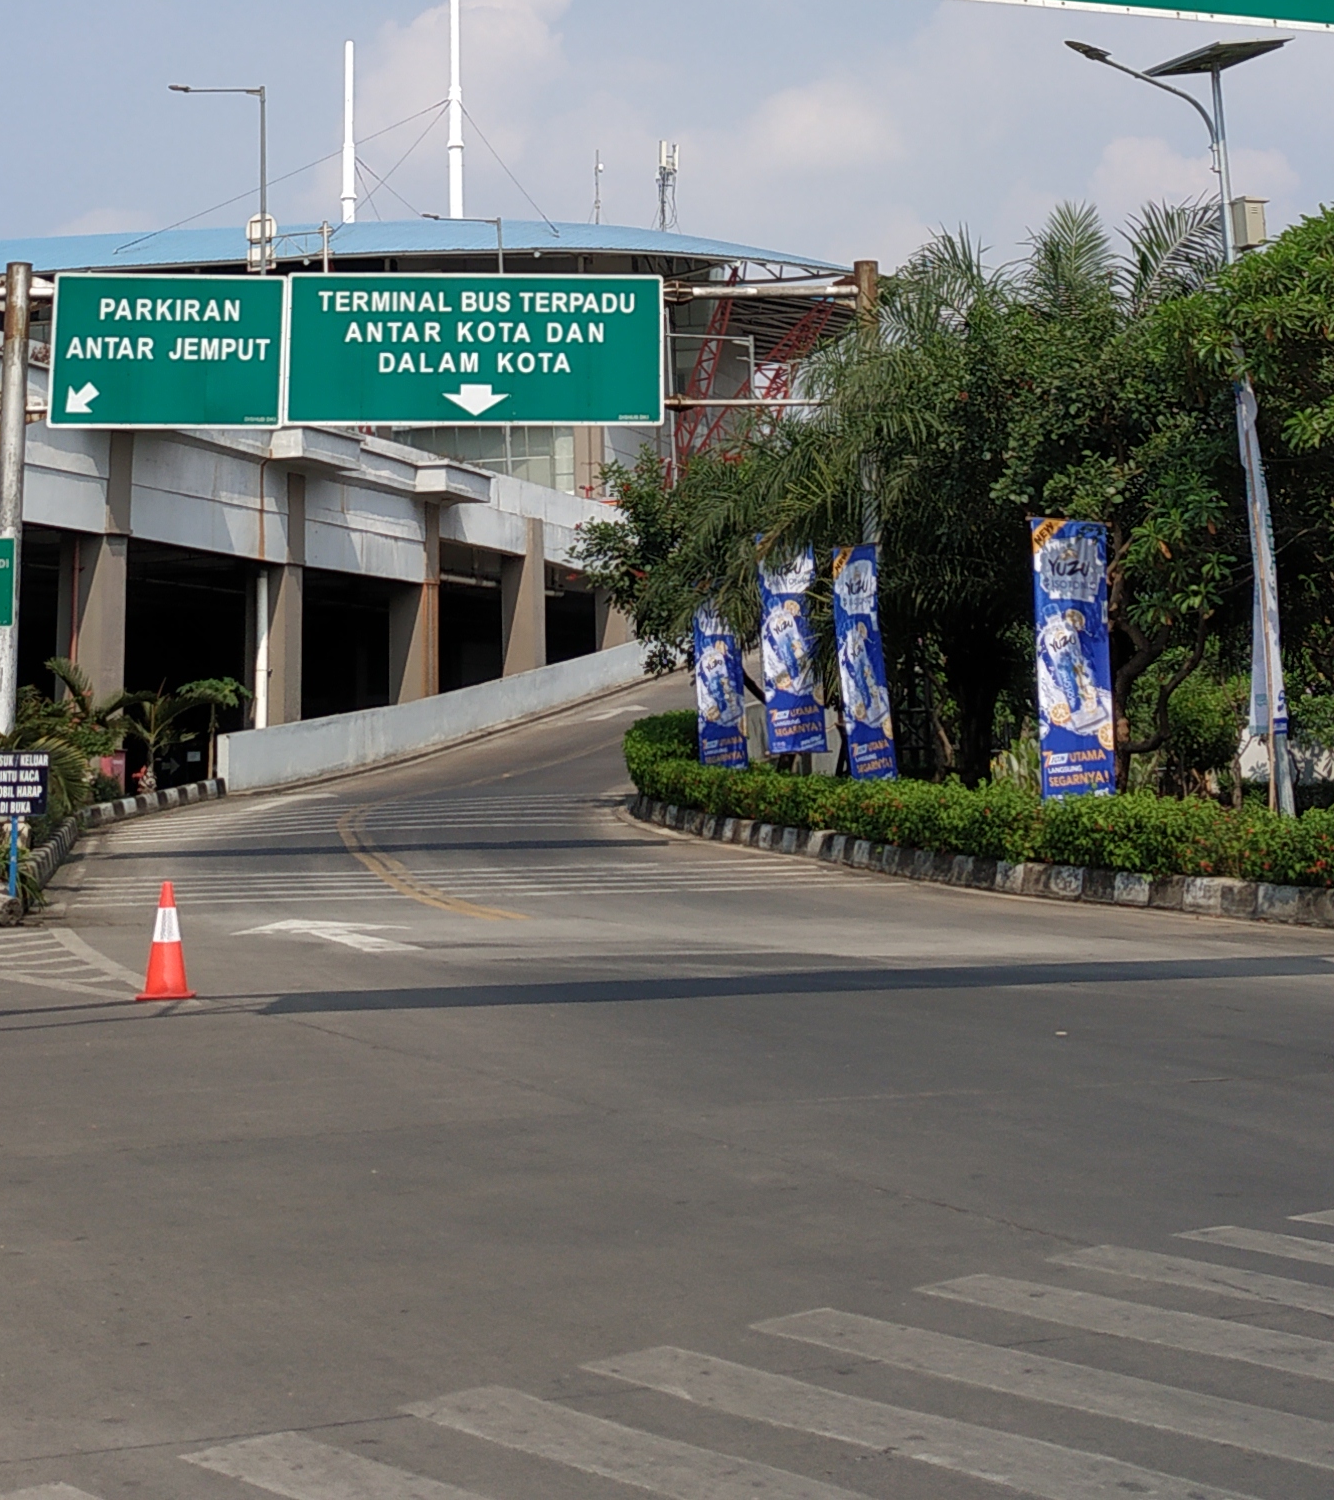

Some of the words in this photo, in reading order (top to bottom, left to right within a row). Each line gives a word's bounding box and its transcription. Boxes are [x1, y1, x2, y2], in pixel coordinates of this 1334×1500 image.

[98, 298, 242, 323] PARKIRAN
[318, 290, 453, 314] TERMINAL
[460, 291, 512, 314] BUS
[519, 292, 636, 315] TERPADU
[344, 321, 442, 344] ANTAR
[457, 321, 533, 344] KOTA
[546, 322, 605, 344] DAN
[65, 336, 155, 361] ANTAR
[168, 337, 271, 362] JEMPUT
[378, 351, 480, 374] DALAM
[496, 351, 571, 374] KOTA
[1035, 521, 1055, 546] NEW
[834, 551, 848, 572] NEW
[1048, 557, 1091, 578] YUZU
[1049, 635, 1076, 653] YUZU
[20, 754, 49, 767] KELUAR
[1069, 750, 1107, 763] UTAMA
[19, 769, 40, 782] KACA
[1048, 770, 1110, 788] SEGARNYA!
[16, 785, 43, 798] HARAP
[0, 801, 8, 814] DI
[10, 801, 31, 813] BUKA
